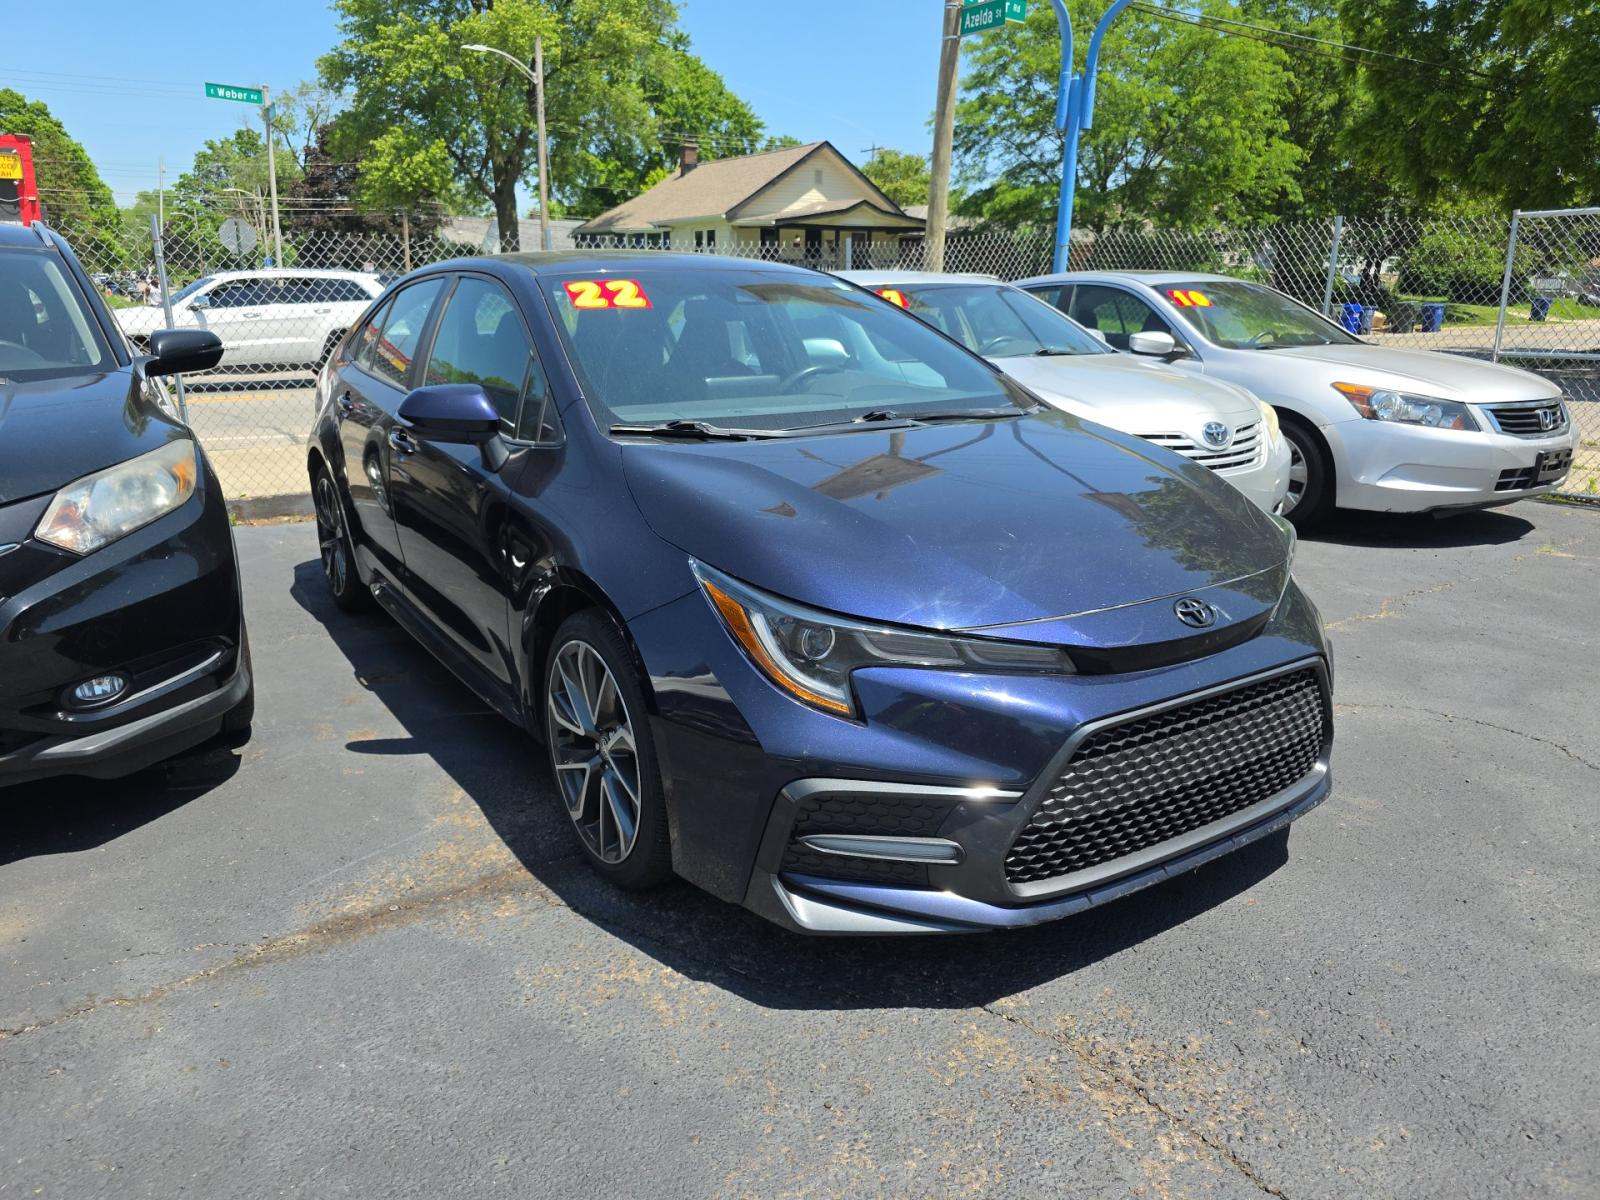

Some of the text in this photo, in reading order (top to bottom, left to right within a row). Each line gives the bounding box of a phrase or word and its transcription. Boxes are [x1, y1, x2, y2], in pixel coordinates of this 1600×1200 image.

[965, 8, 993, 29] Azelda
[217, 87, 248, 100] Weber
[567, 280, 648, 307] 22
